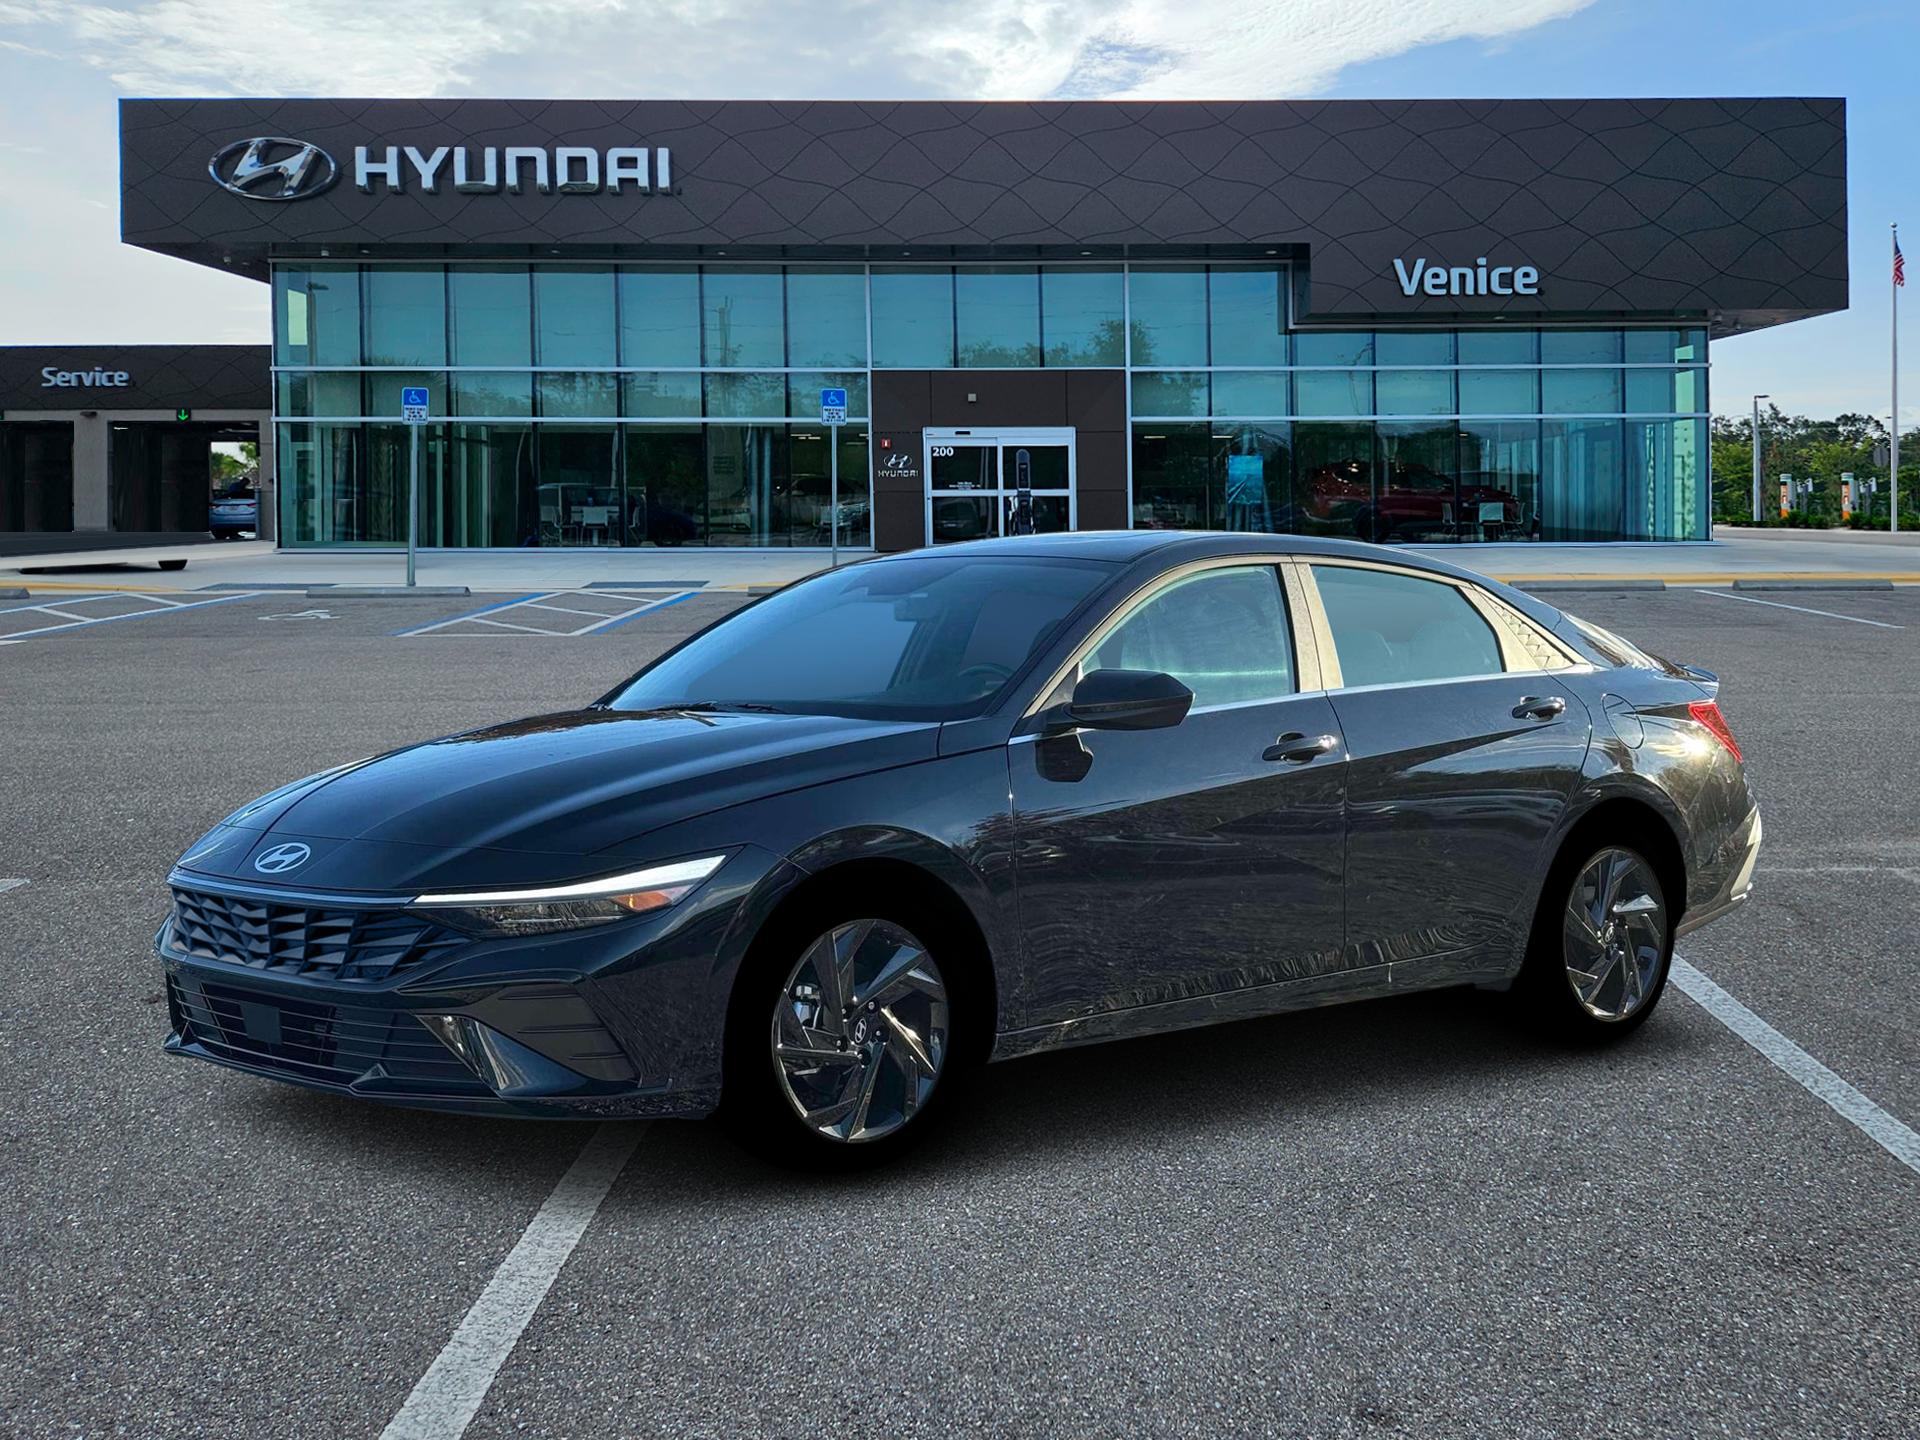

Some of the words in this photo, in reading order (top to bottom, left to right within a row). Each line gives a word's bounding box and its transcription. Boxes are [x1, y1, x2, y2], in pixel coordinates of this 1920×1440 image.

[354, 145, 671, 194] HYUNDAI
[1393, 257, 1539, 296] Venice
[41, 367, 129, 387] Service
[932, 447, 954, 457] 200
[877, 470, 919, 478] HYUNDAI
